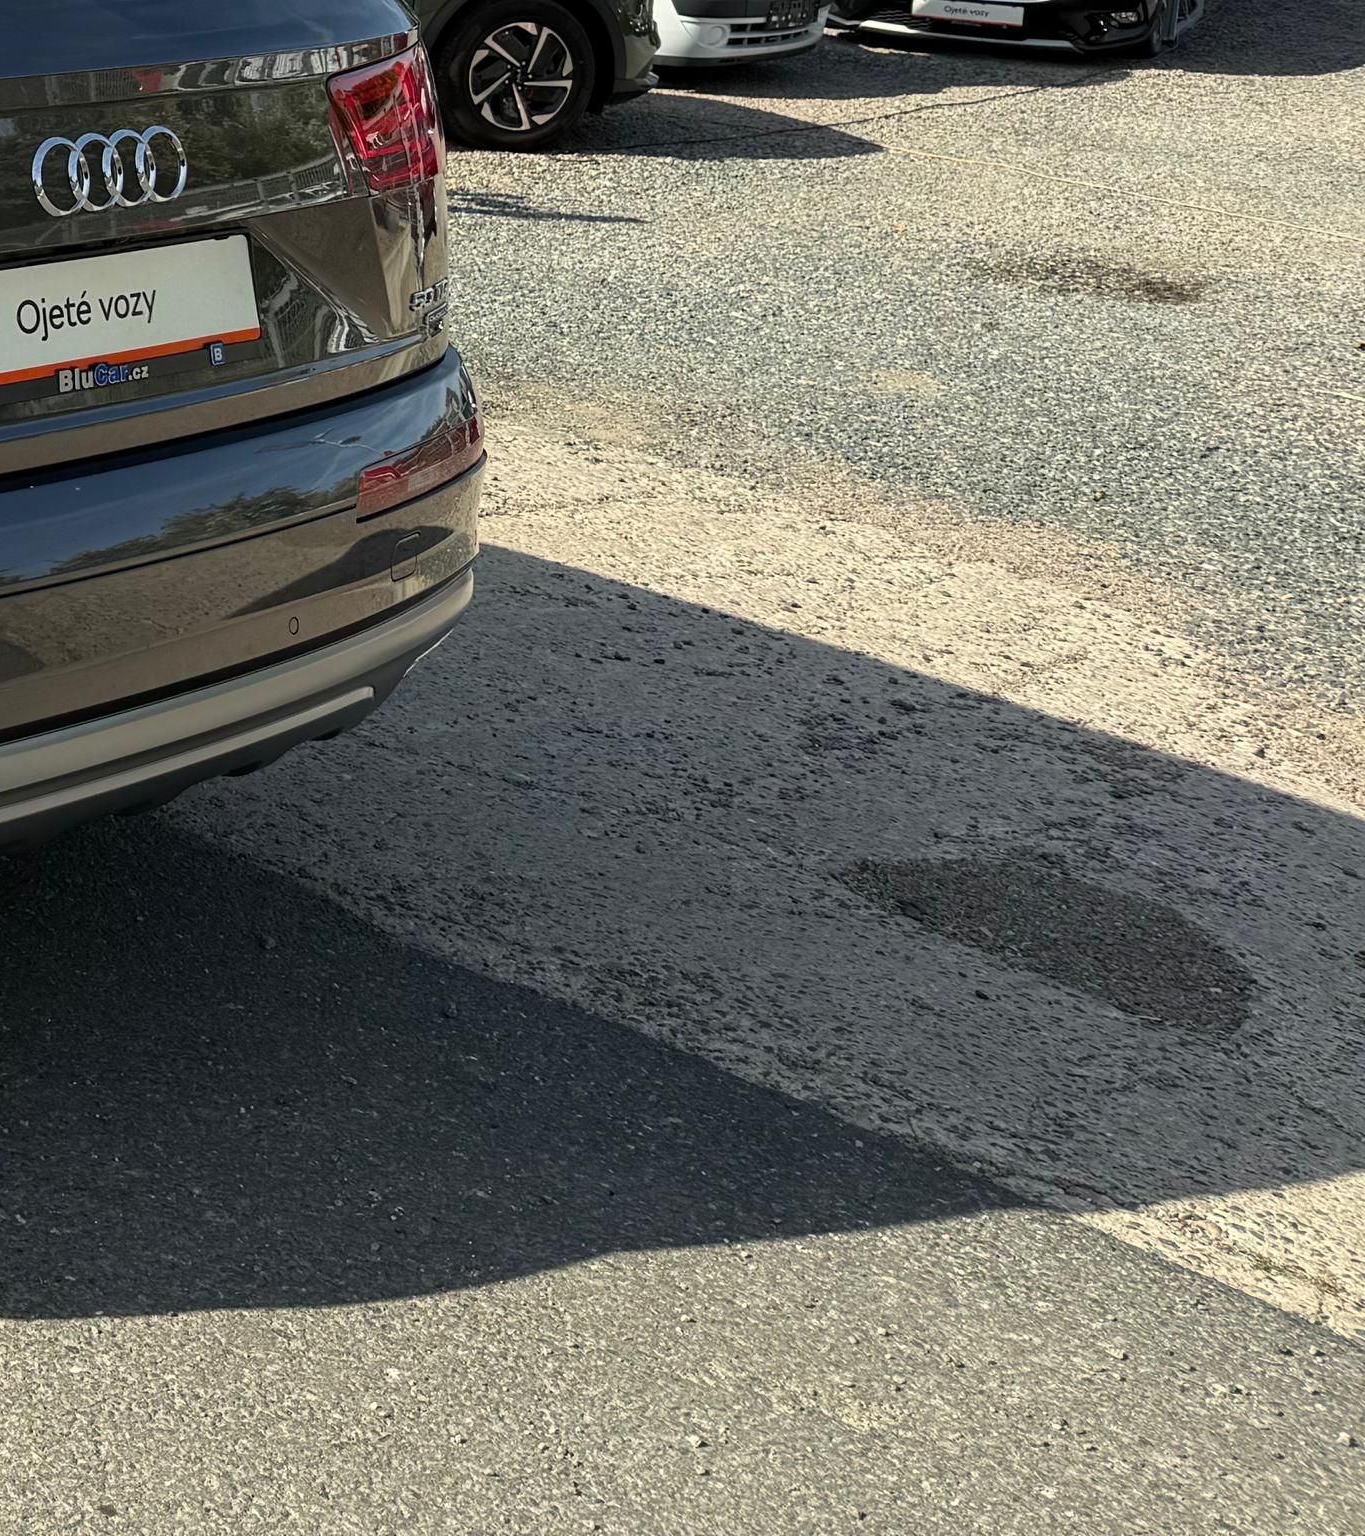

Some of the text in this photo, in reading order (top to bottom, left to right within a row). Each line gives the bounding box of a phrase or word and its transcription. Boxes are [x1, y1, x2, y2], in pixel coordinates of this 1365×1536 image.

[16, 289, 157, 342] Ojeté vozy
[58, 362, 149, 393] BluCar.cz
